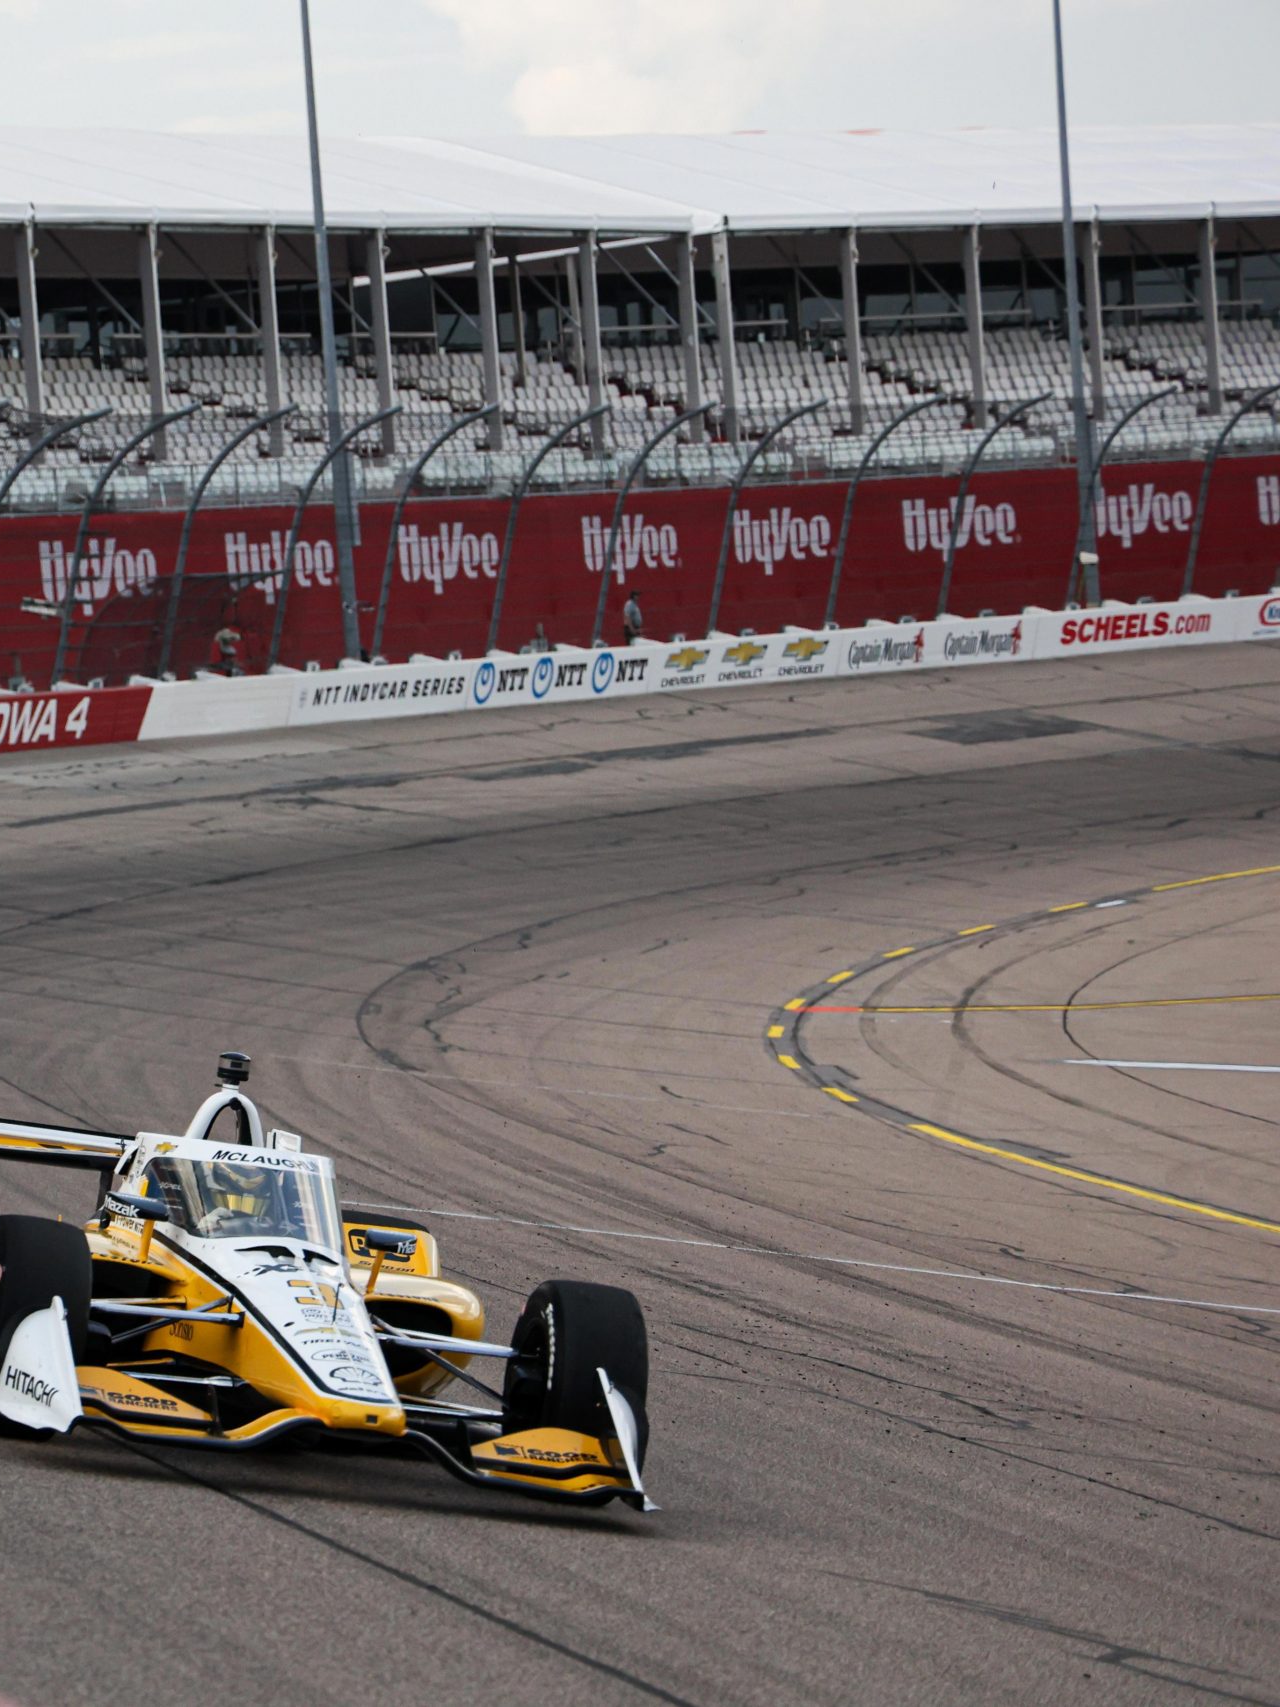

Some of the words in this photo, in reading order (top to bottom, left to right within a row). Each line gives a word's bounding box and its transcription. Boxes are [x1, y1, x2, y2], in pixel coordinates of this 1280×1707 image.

[1061, 612, 1211, 645] SCHEELS.com
[497, 668, 529, 692] NTT
[555, 663, 587, 687] NTT
[615, 658, 648, 682] NTT
[661, 674, 705, 687] CHEVROLET
[718, 668, 763, 681] CHEVROLET
[778, 664, 824, 676] CHEVROLET
[312, 685, 342, 706] NTT
[344, 680, 408, 703] INDYCAR
[412, 676, 465, 697] SERIES
[65, 696, 91, 739] 4
[212, 1150, 318, 1171] MCLAUG
[104, 1194, 140, 1218] Mazak
[5, 1365, 59, 1407] HITACHI
[107, 1391, 178, 1406] GOOD
